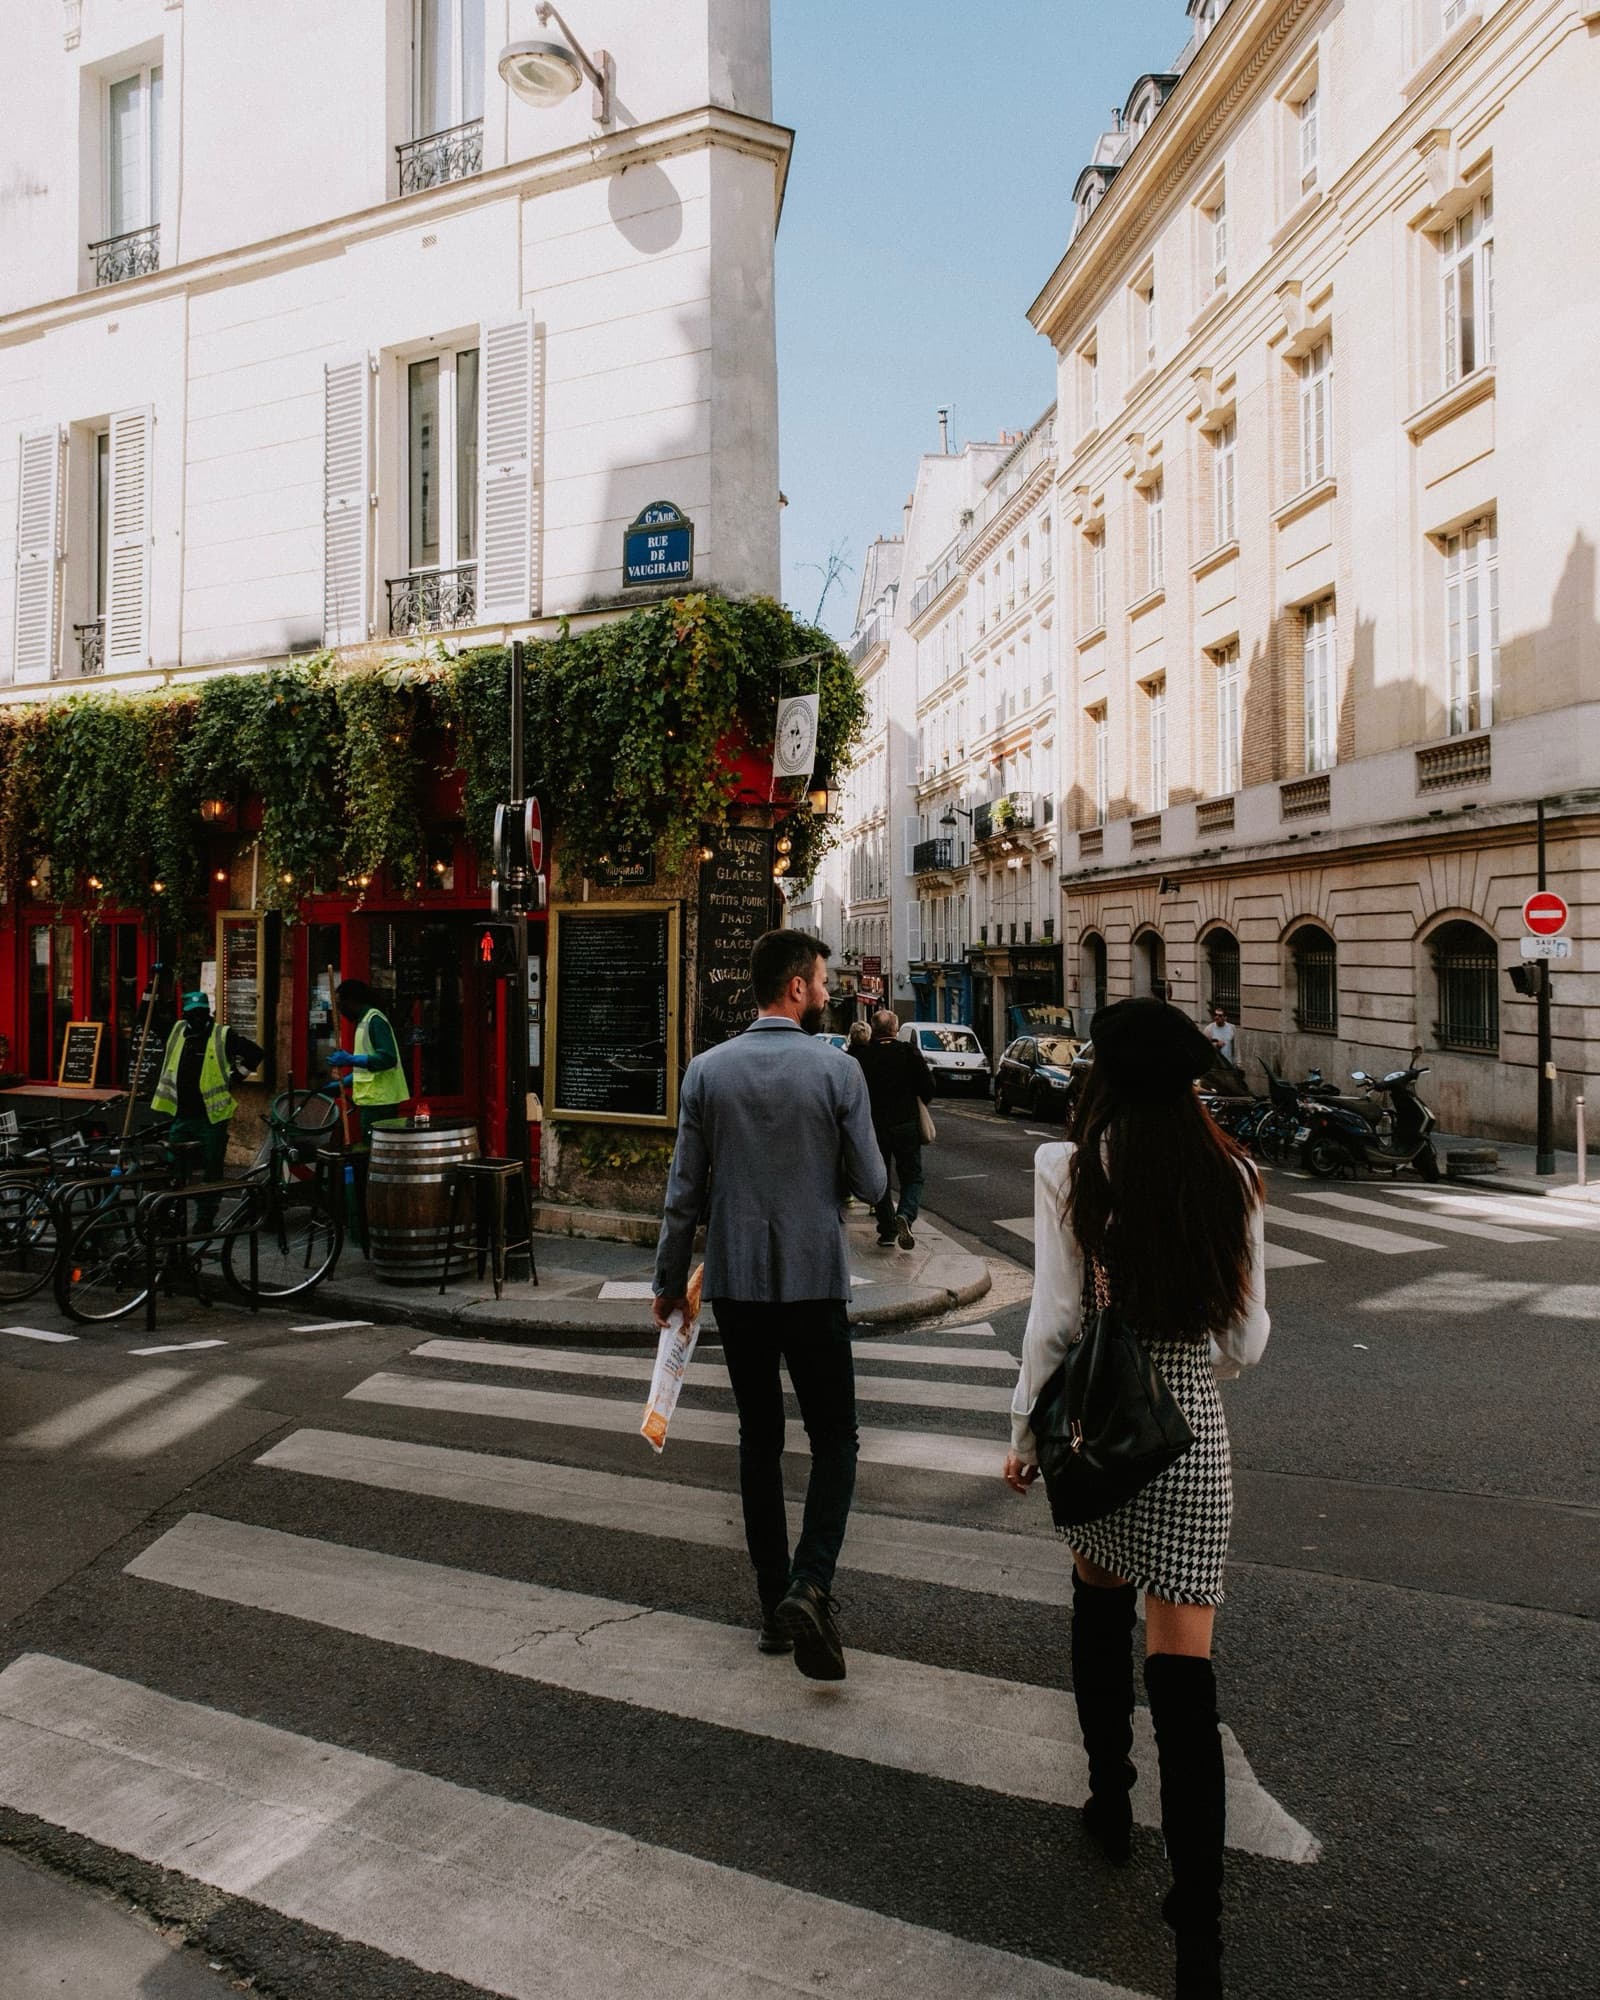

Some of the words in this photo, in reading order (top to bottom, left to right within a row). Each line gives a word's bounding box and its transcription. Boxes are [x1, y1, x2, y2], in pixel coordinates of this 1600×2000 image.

[648, 536, 668, 548] RUE
[650, 550, 665, 561] DE
[628, 561, 688, 577] VAUGIRARD
[716, 867, 763, 881] GLACES
[710, 893, 740, 906] PETITS
[720, 913, 753, 925] FRAIS
[711, 1005, 759, 1023] ALSACE
